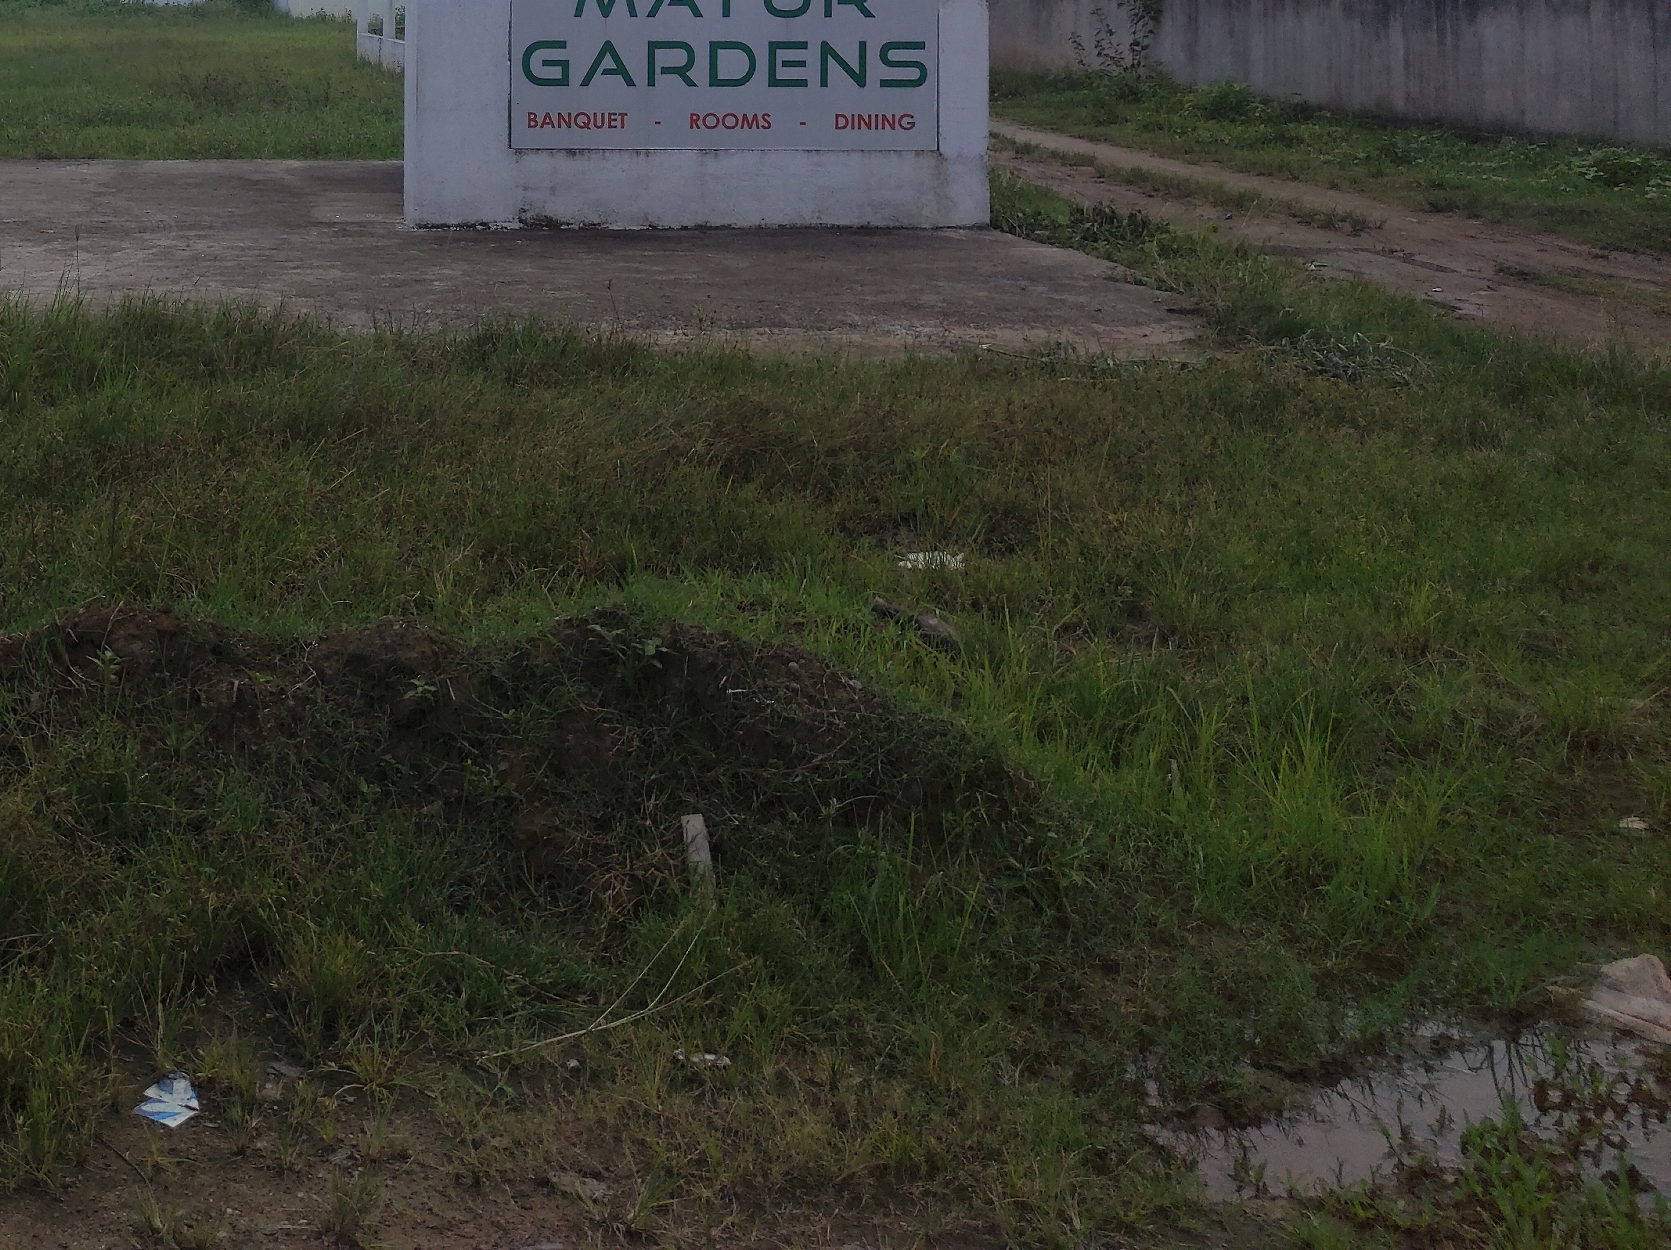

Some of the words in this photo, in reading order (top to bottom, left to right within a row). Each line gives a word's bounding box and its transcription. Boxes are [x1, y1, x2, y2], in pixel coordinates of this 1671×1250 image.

[521, 40, 927, 88] GARDENS
[527, 111, 628, 130] BANQUET
[689, 112, 772, 131] ROOMS
[835, 113, 916, 131] DINING
